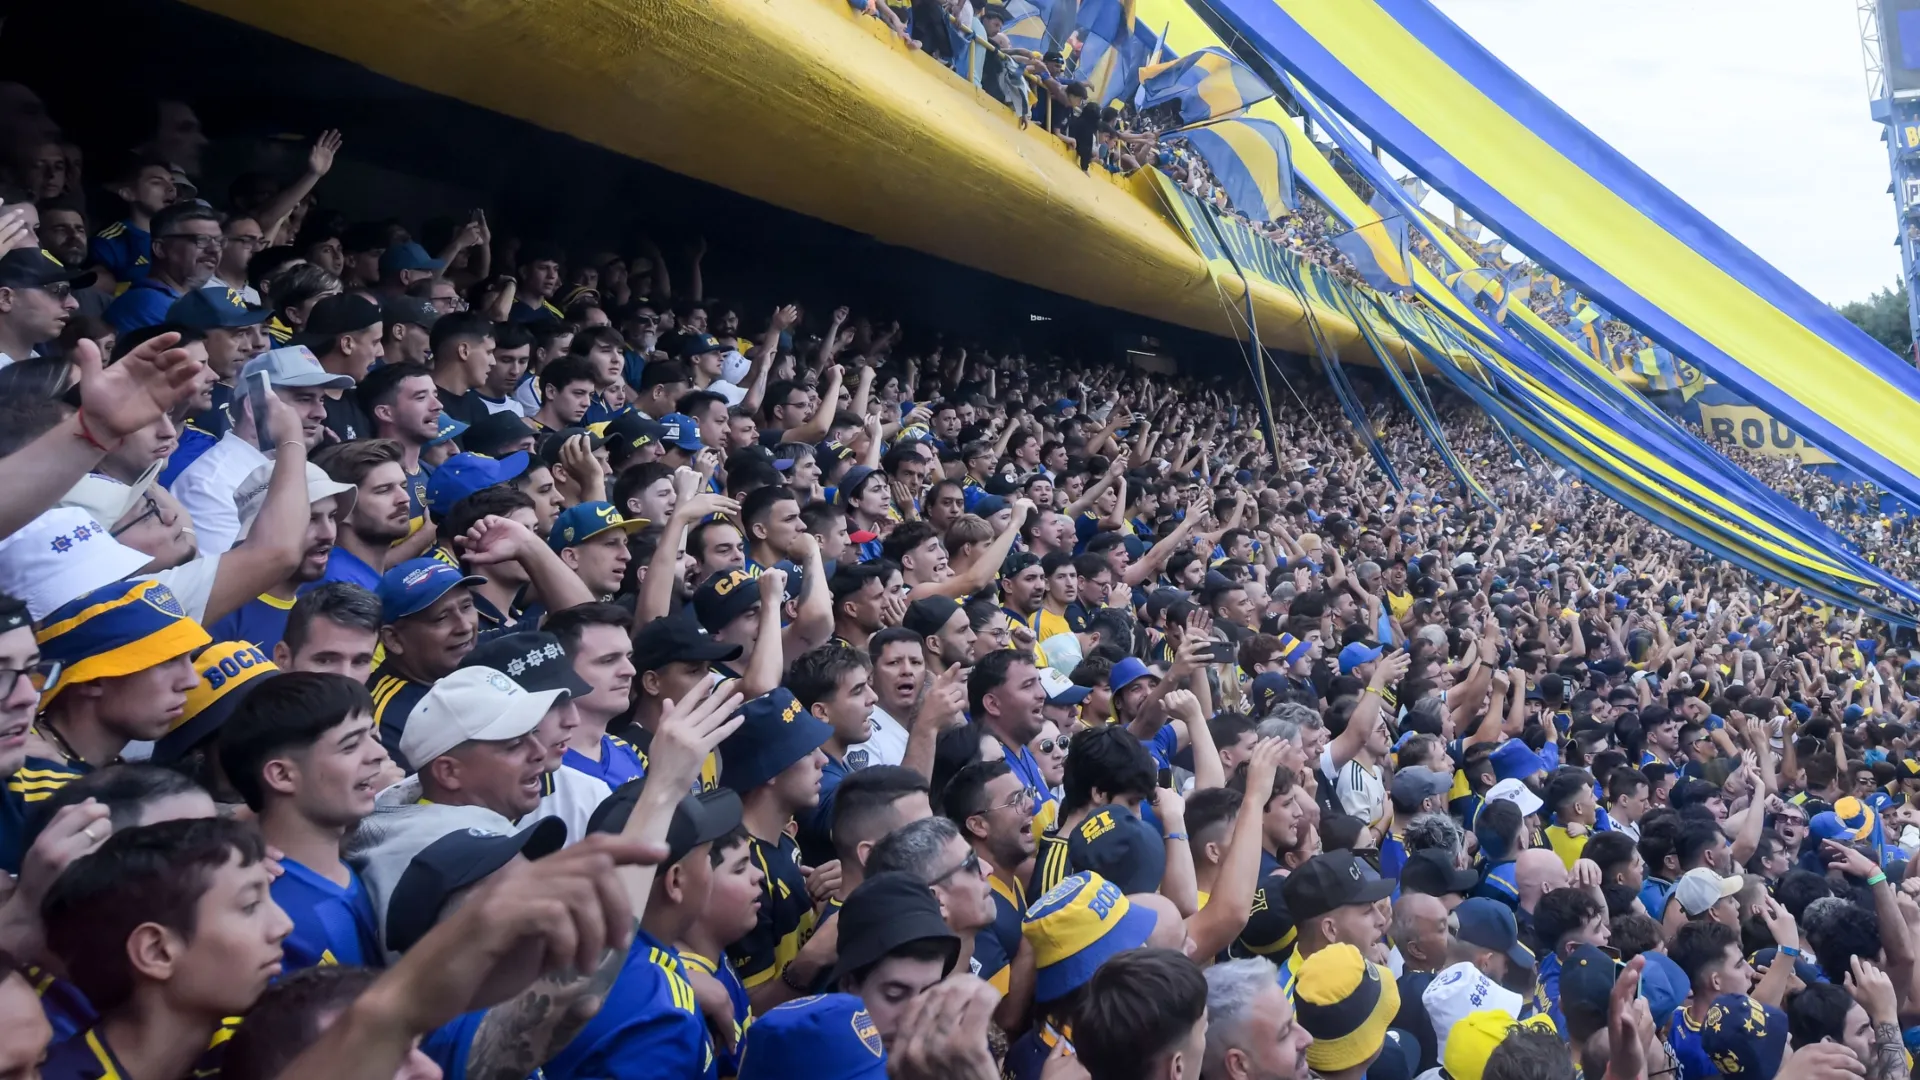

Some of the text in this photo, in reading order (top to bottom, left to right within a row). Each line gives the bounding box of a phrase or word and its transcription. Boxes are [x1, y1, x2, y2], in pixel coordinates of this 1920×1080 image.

[1905, 126, 1920, 148] B
[1710, 417, 1815, 449] BOU
[714, 568, 753, 596] CA
[203, 647, 269, 690] BOCA
[1081, 810, 1114, 839] 12
